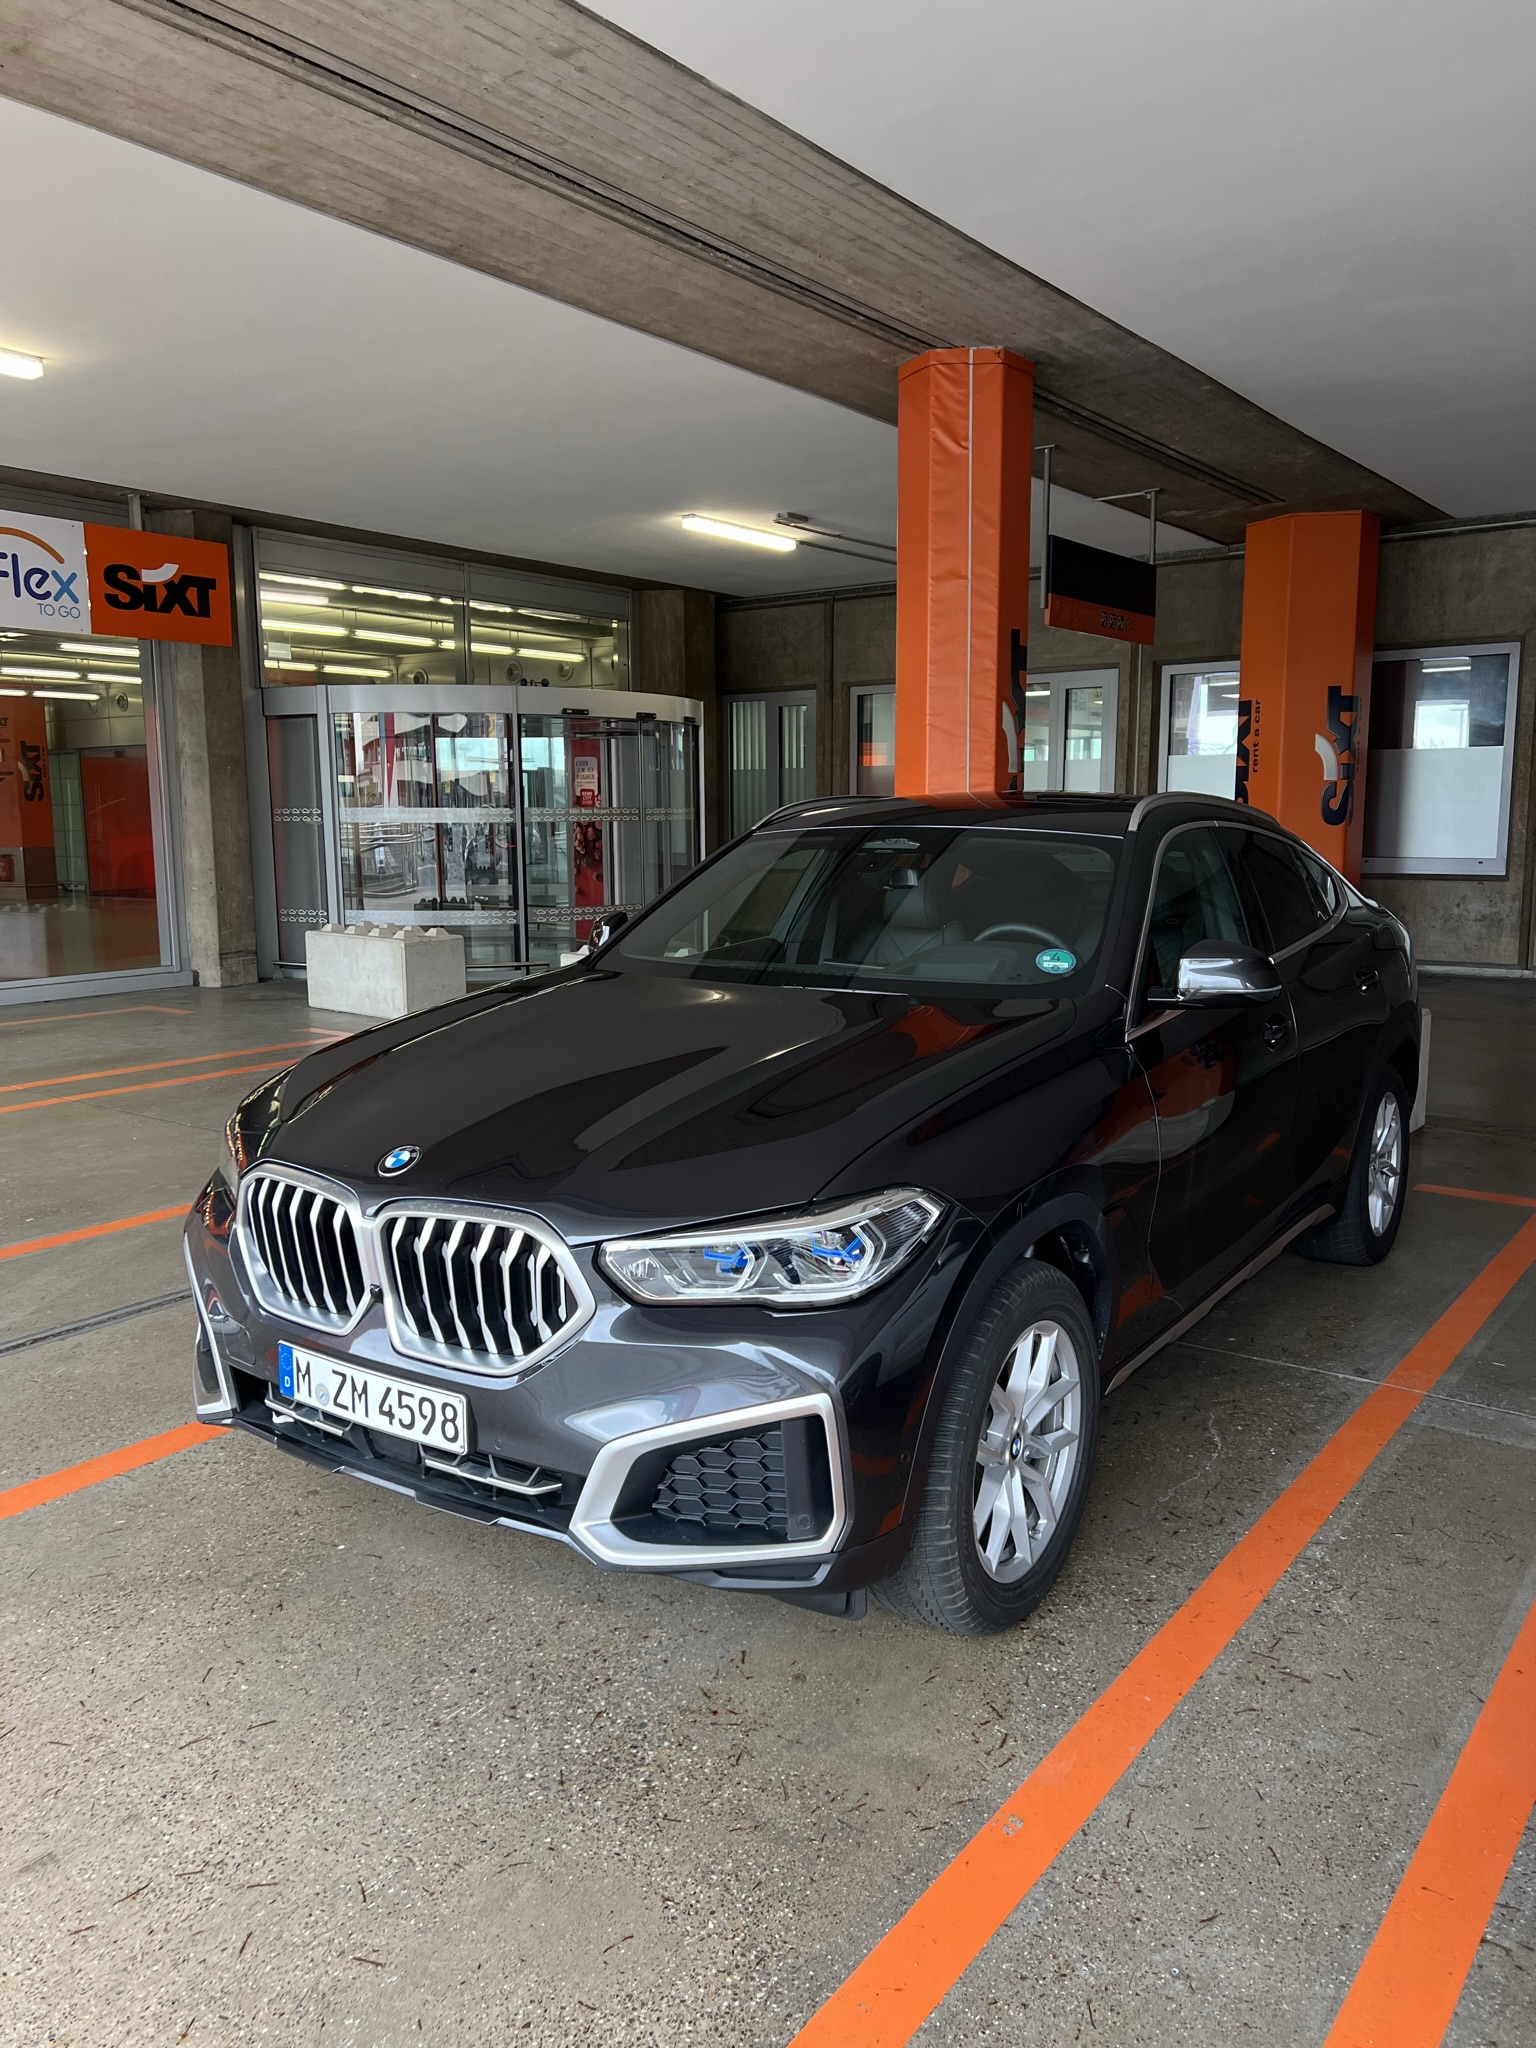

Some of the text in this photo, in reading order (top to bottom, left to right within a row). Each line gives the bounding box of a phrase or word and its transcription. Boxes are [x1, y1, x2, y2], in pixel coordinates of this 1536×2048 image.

[37, 603, 81, 619] TO GO
[1254, 728, 1260, 737] a
[1252, 741, 1260, 773] rent
[284, 1375, 291, 1388] D
[295, 1356, 460, 1444] M ZM 4598
